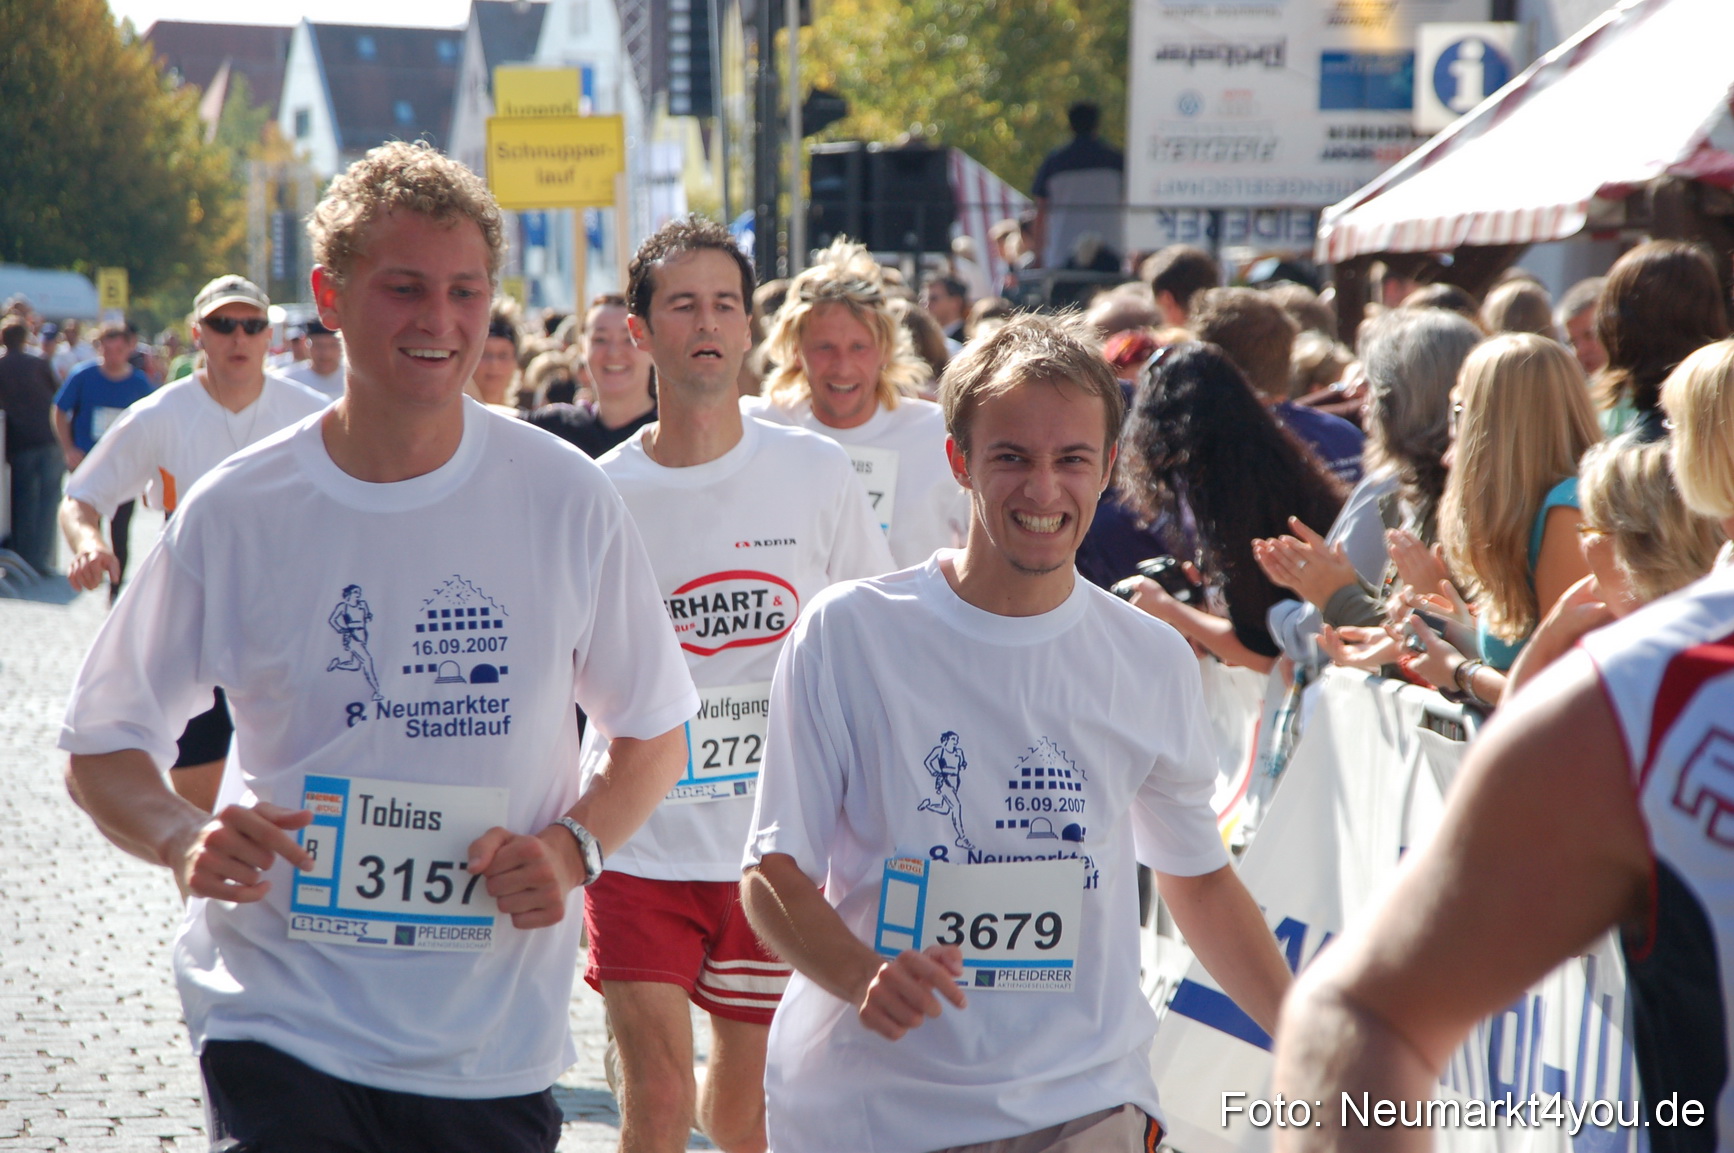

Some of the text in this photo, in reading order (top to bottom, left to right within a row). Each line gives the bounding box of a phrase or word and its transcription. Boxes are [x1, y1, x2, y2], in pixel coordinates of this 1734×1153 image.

[664, 589, 768, 620] RHART
[412, 636, 509, 656] 16.09.2007
[376, 695, 510, 720] Neumarkter
[697, 697, 769, 721] Wolfgang
[406, 715, 511, 738] Stadtlauf
[702, 734, 768, 769] 272
[359, 794, 442, 831] Tobias
[1005, 796, 1086, 814] 16.09.2007
[356, 855, 482, 905] 3157
[291, 916, 368, 936] BOCK
[418, 926, 492, 941] PFLEIDERER
[936, 911, 1063, 950] 3679
[998, 970, 1072, 982] PFLEIDERER
